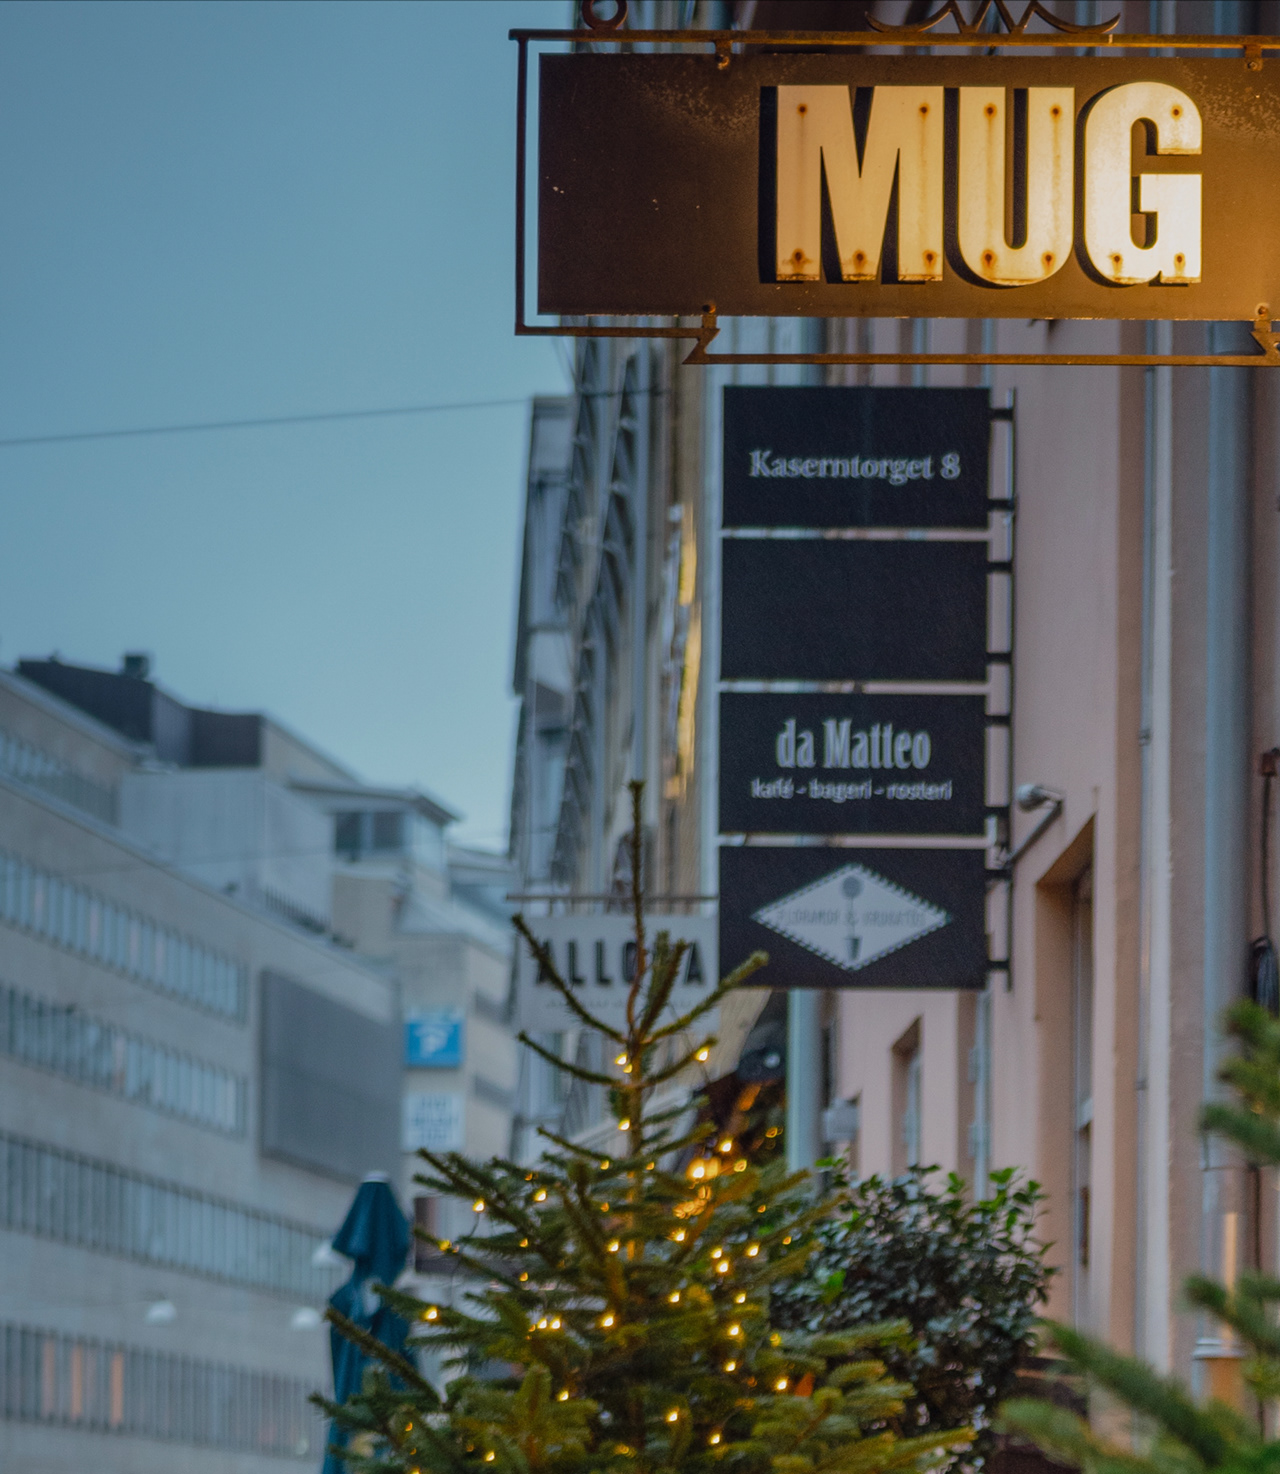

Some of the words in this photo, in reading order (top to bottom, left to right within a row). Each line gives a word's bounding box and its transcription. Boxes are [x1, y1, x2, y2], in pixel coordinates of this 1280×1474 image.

[774, 81, 1203, 286] MUG
[748, 449, 935, 486] Kaserntorget
[940, 451, 961, 480] 8
[776, 718, 816, 769] da
[822, 718, 931, 769] Matteo
[751, 777, 795, 799] kafé
[808, 777, 873, 803] bageri
[536, 940, 706, 985] ALLOA
